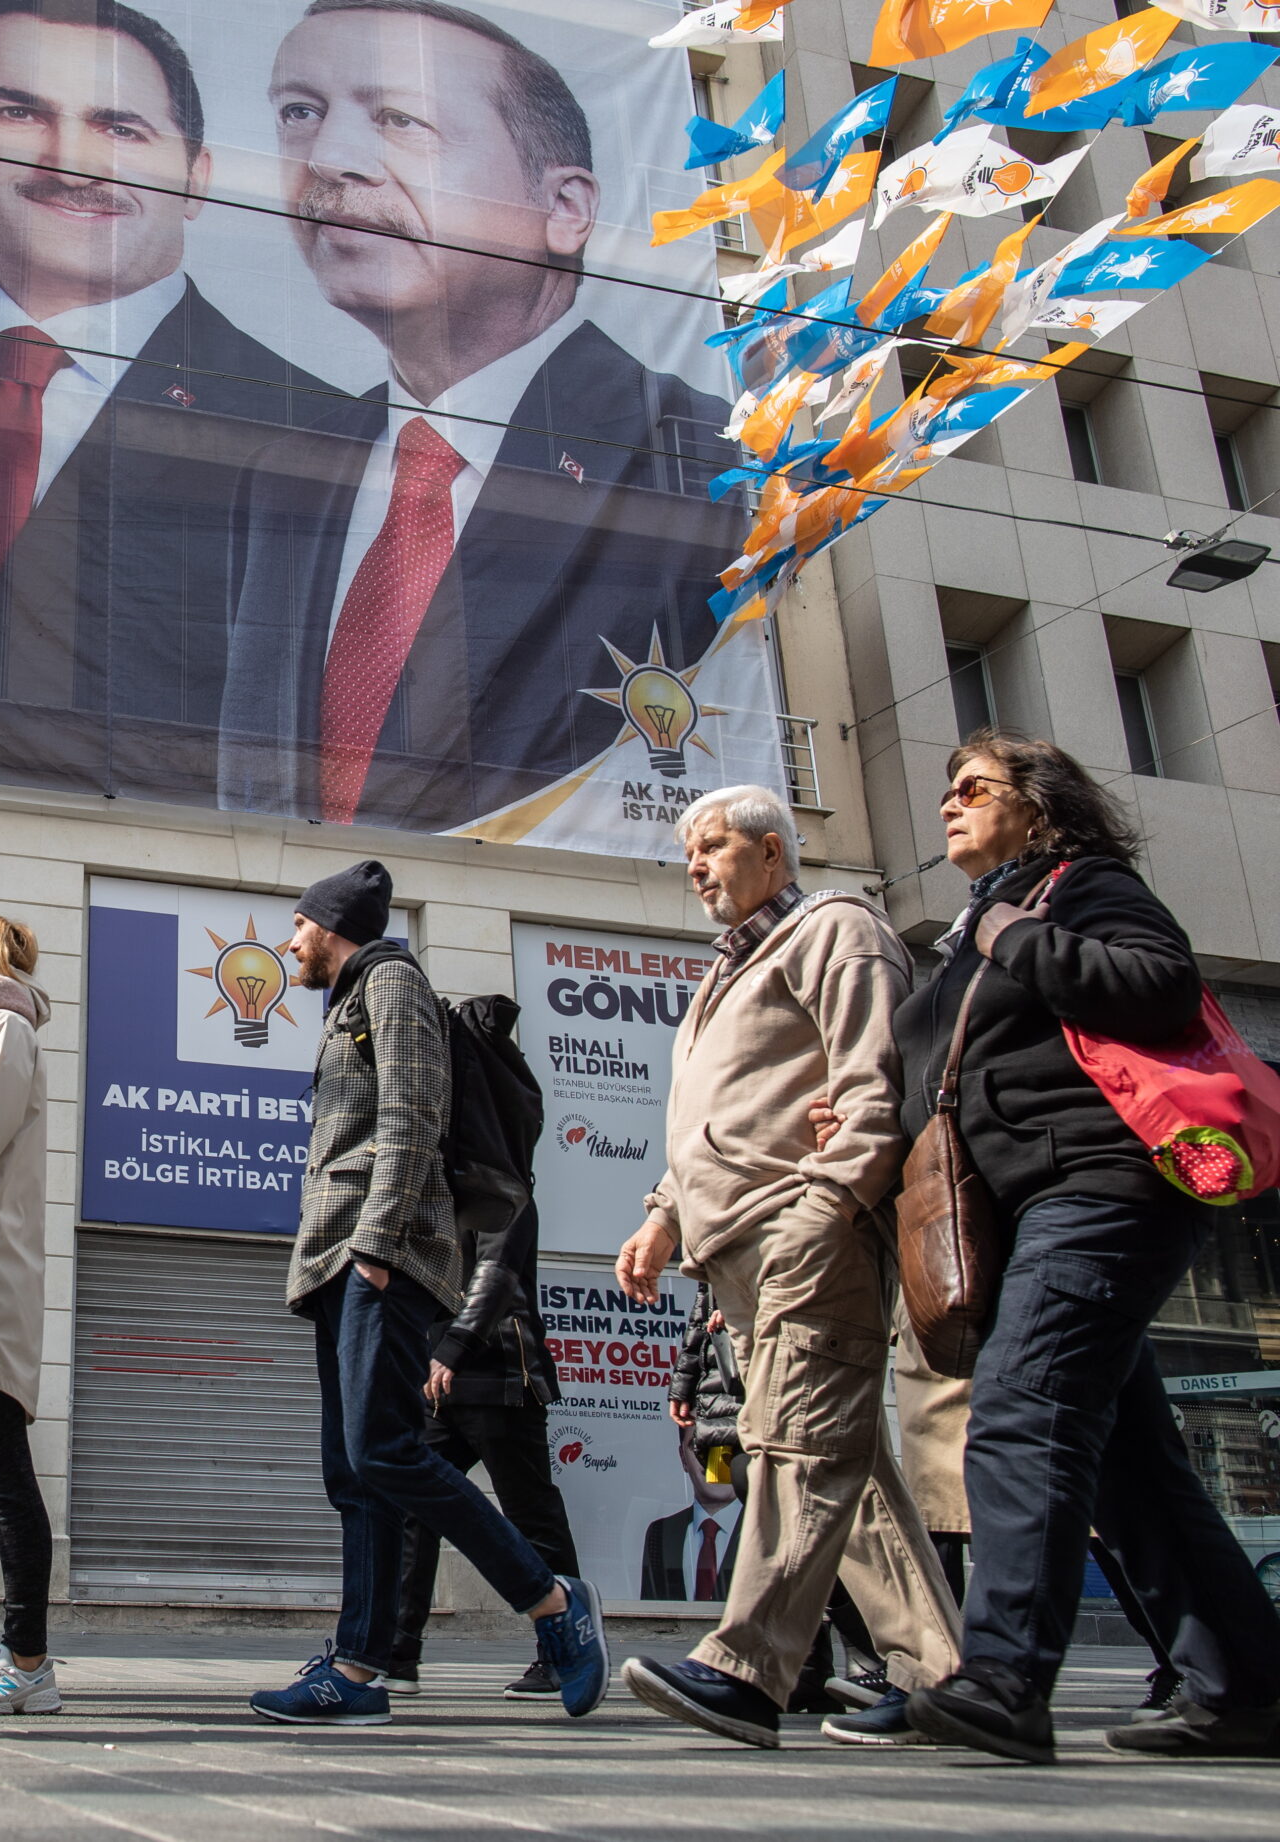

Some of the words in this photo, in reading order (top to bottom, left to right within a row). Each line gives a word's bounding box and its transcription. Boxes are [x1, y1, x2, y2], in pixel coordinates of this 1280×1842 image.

[621, 780, 654, 801] AK
[661, 784, 710, 805] PAR
[623, 801, 684, 824] İSTAN
[547, 975, 694, 1028] GÖNÜ
[548, 1033, 624, 1060] BİNALİ
[548, 1054, 649, 1080] YILDIRIM
[553, 1077, 595, 1090] İSTANBUL
[597, 1082, 652, 1094] BÜYÜKŞEHİR
[553, 1089, 595, 1101] BELEDİYE
[597, 1094, 634, 1104] BAŞKAN
[636, 1098, 662, 1107] ADAYI
[102, 1083, 151, 1110] AK
[157, 1088, 250, 1118] PARTİ
[140, 1127, 251, 1162] İSTİKLAL
[586, 1130, 649, 1161] İstanbul
[104, 1156, 189, 1184] BÖLGE
[197, 1161, 290, 1193] İRTİBAT
[541, 1313, 612, 1335] BENİM
[618, 1318, 687, 1340] AŞKIM
[557, 1366, 606, 1384] ENİM
[1181, 1377, 1219, 1391] DANS
[1222, 1375, 1238, 1388] ET
[549, 1409, 578, 1417] EYOĞLU
[579, 1410, 612, 1419] BELEDİYE
[613, 1412, 641, 1420] BAŞKAN
[550, 1397, 596, 1408] AYDAR
[599, 1396, 619, 1409] ALİ
[621, 1400, 661, 1412] YILDIZ
[582, 1453, 618, 1472] Beyoğlu
